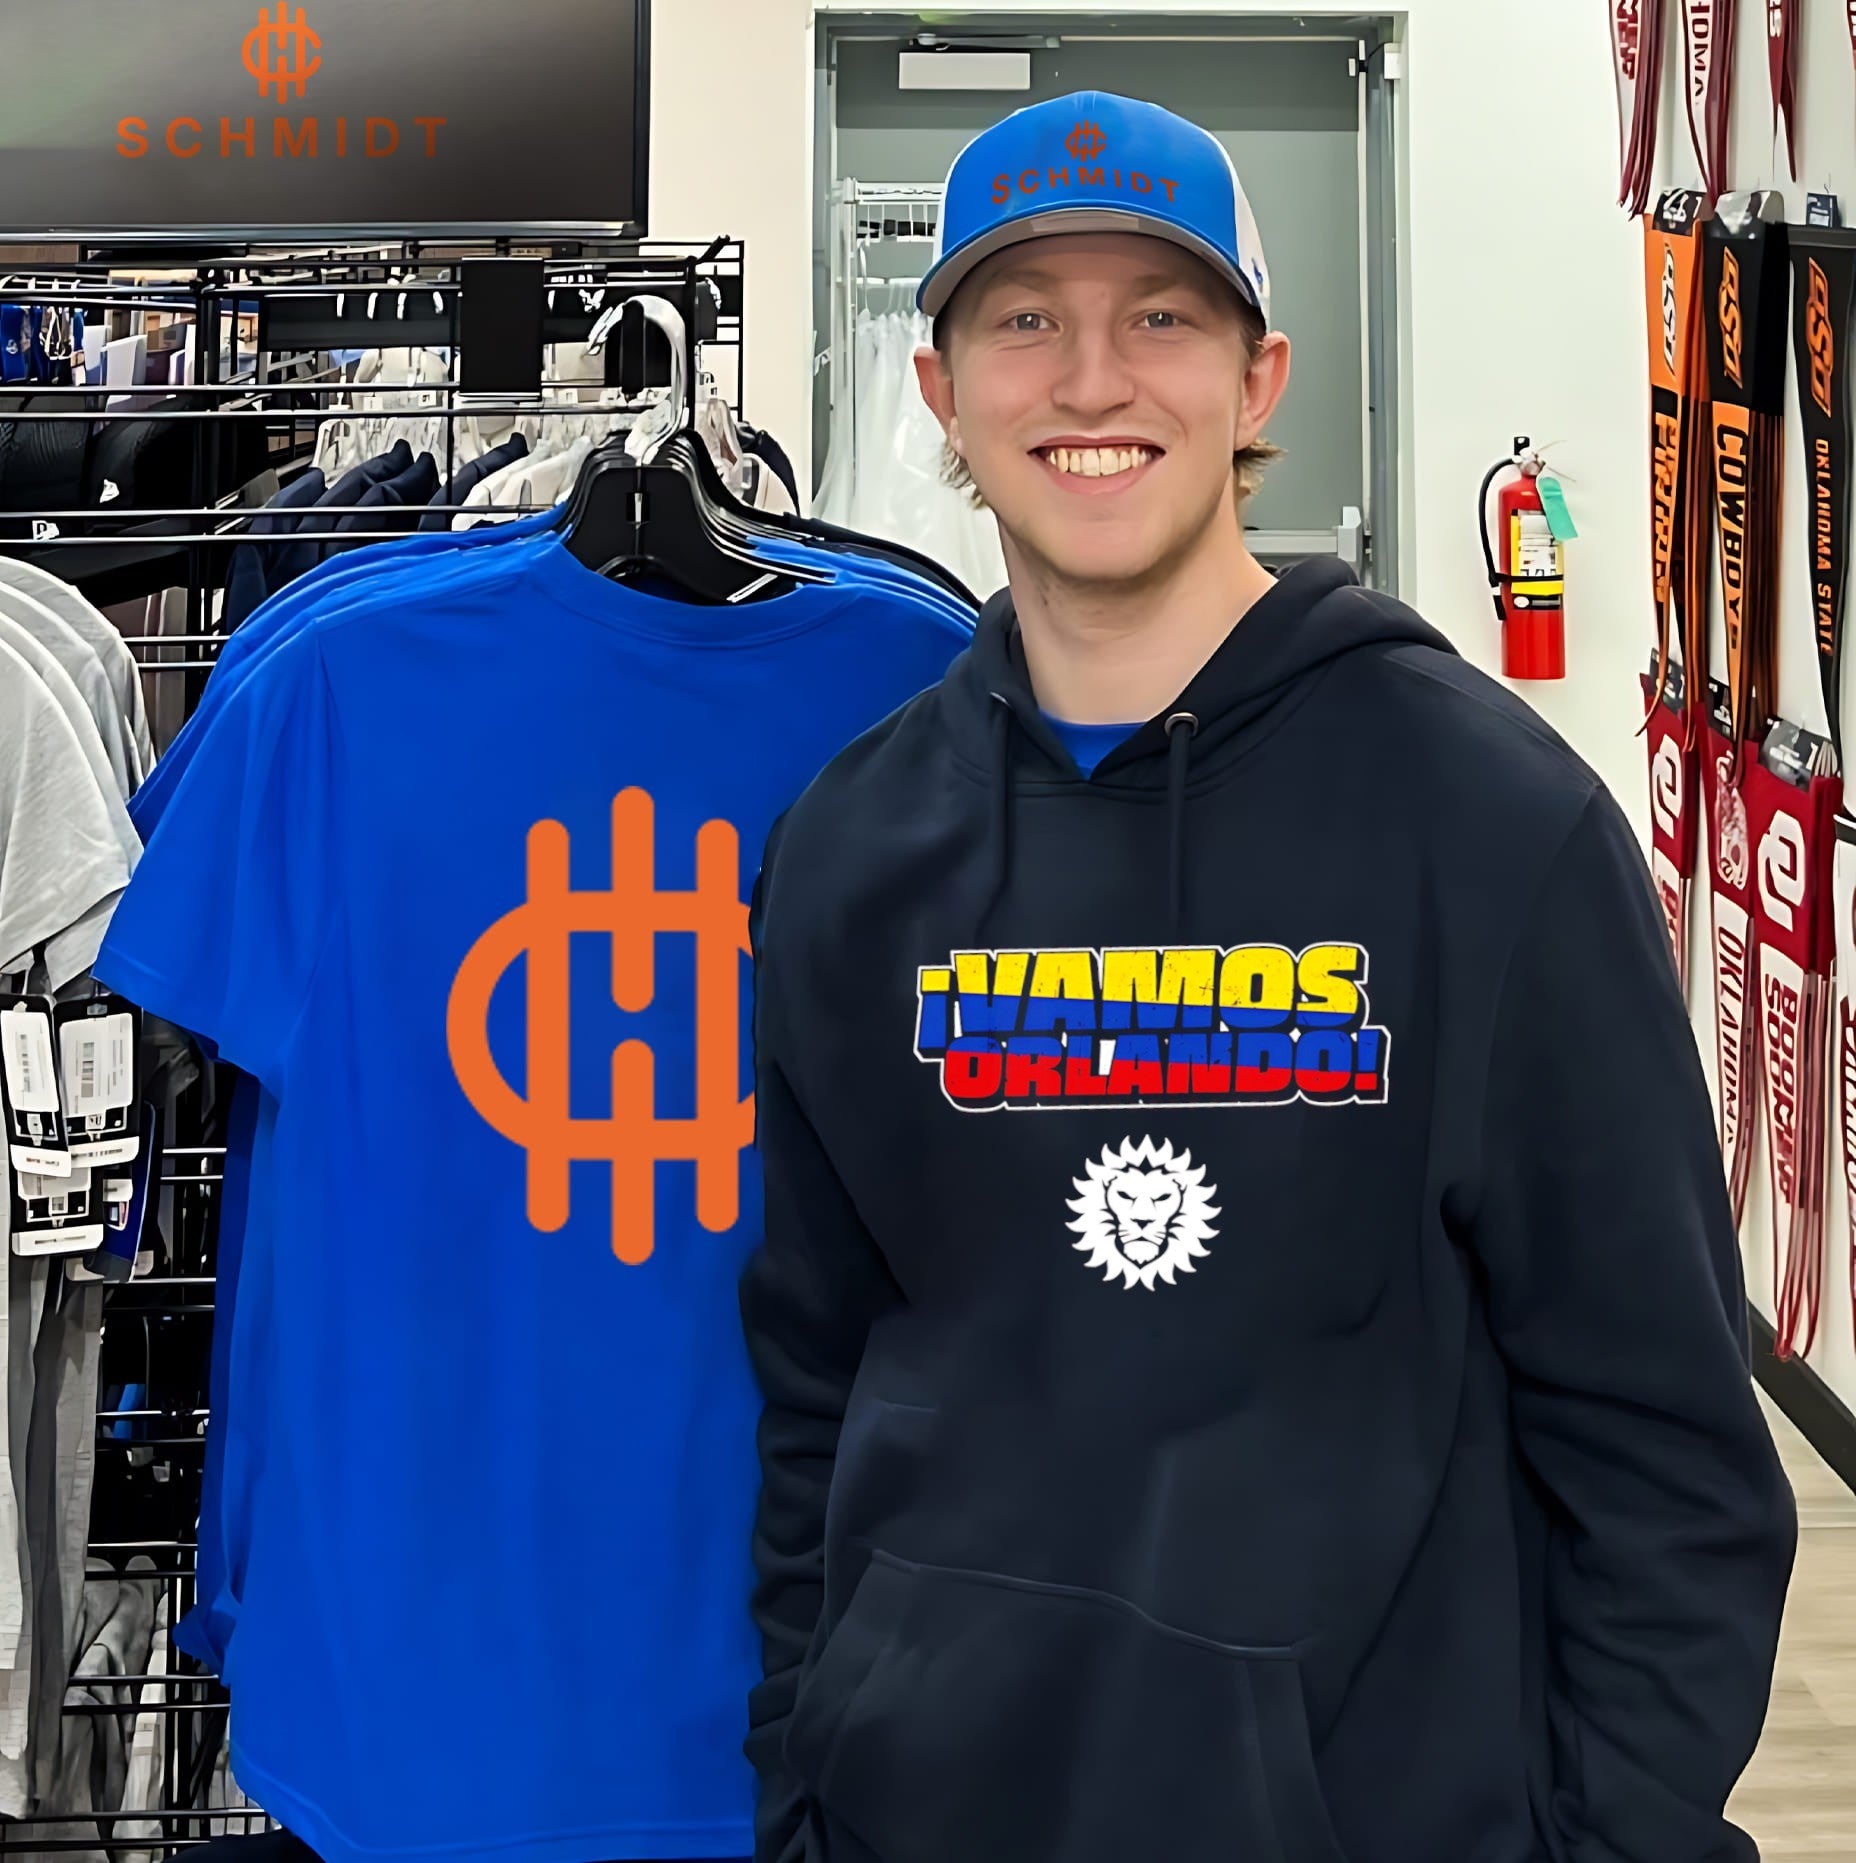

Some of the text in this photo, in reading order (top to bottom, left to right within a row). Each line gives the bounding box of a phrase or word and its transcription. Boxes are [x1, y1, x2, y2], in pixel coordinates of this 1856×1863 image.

[115, 115, 449, 159] SCHMIDT
[991, 166, 1180, 205] SCHMIDT
[1815, 438, 1834, 657] OKLAHOMA STATE
[941, 1028, 1386, 1101] ORLANDO!
[1718, 925, 1745, 1144] OKLAHOMA
